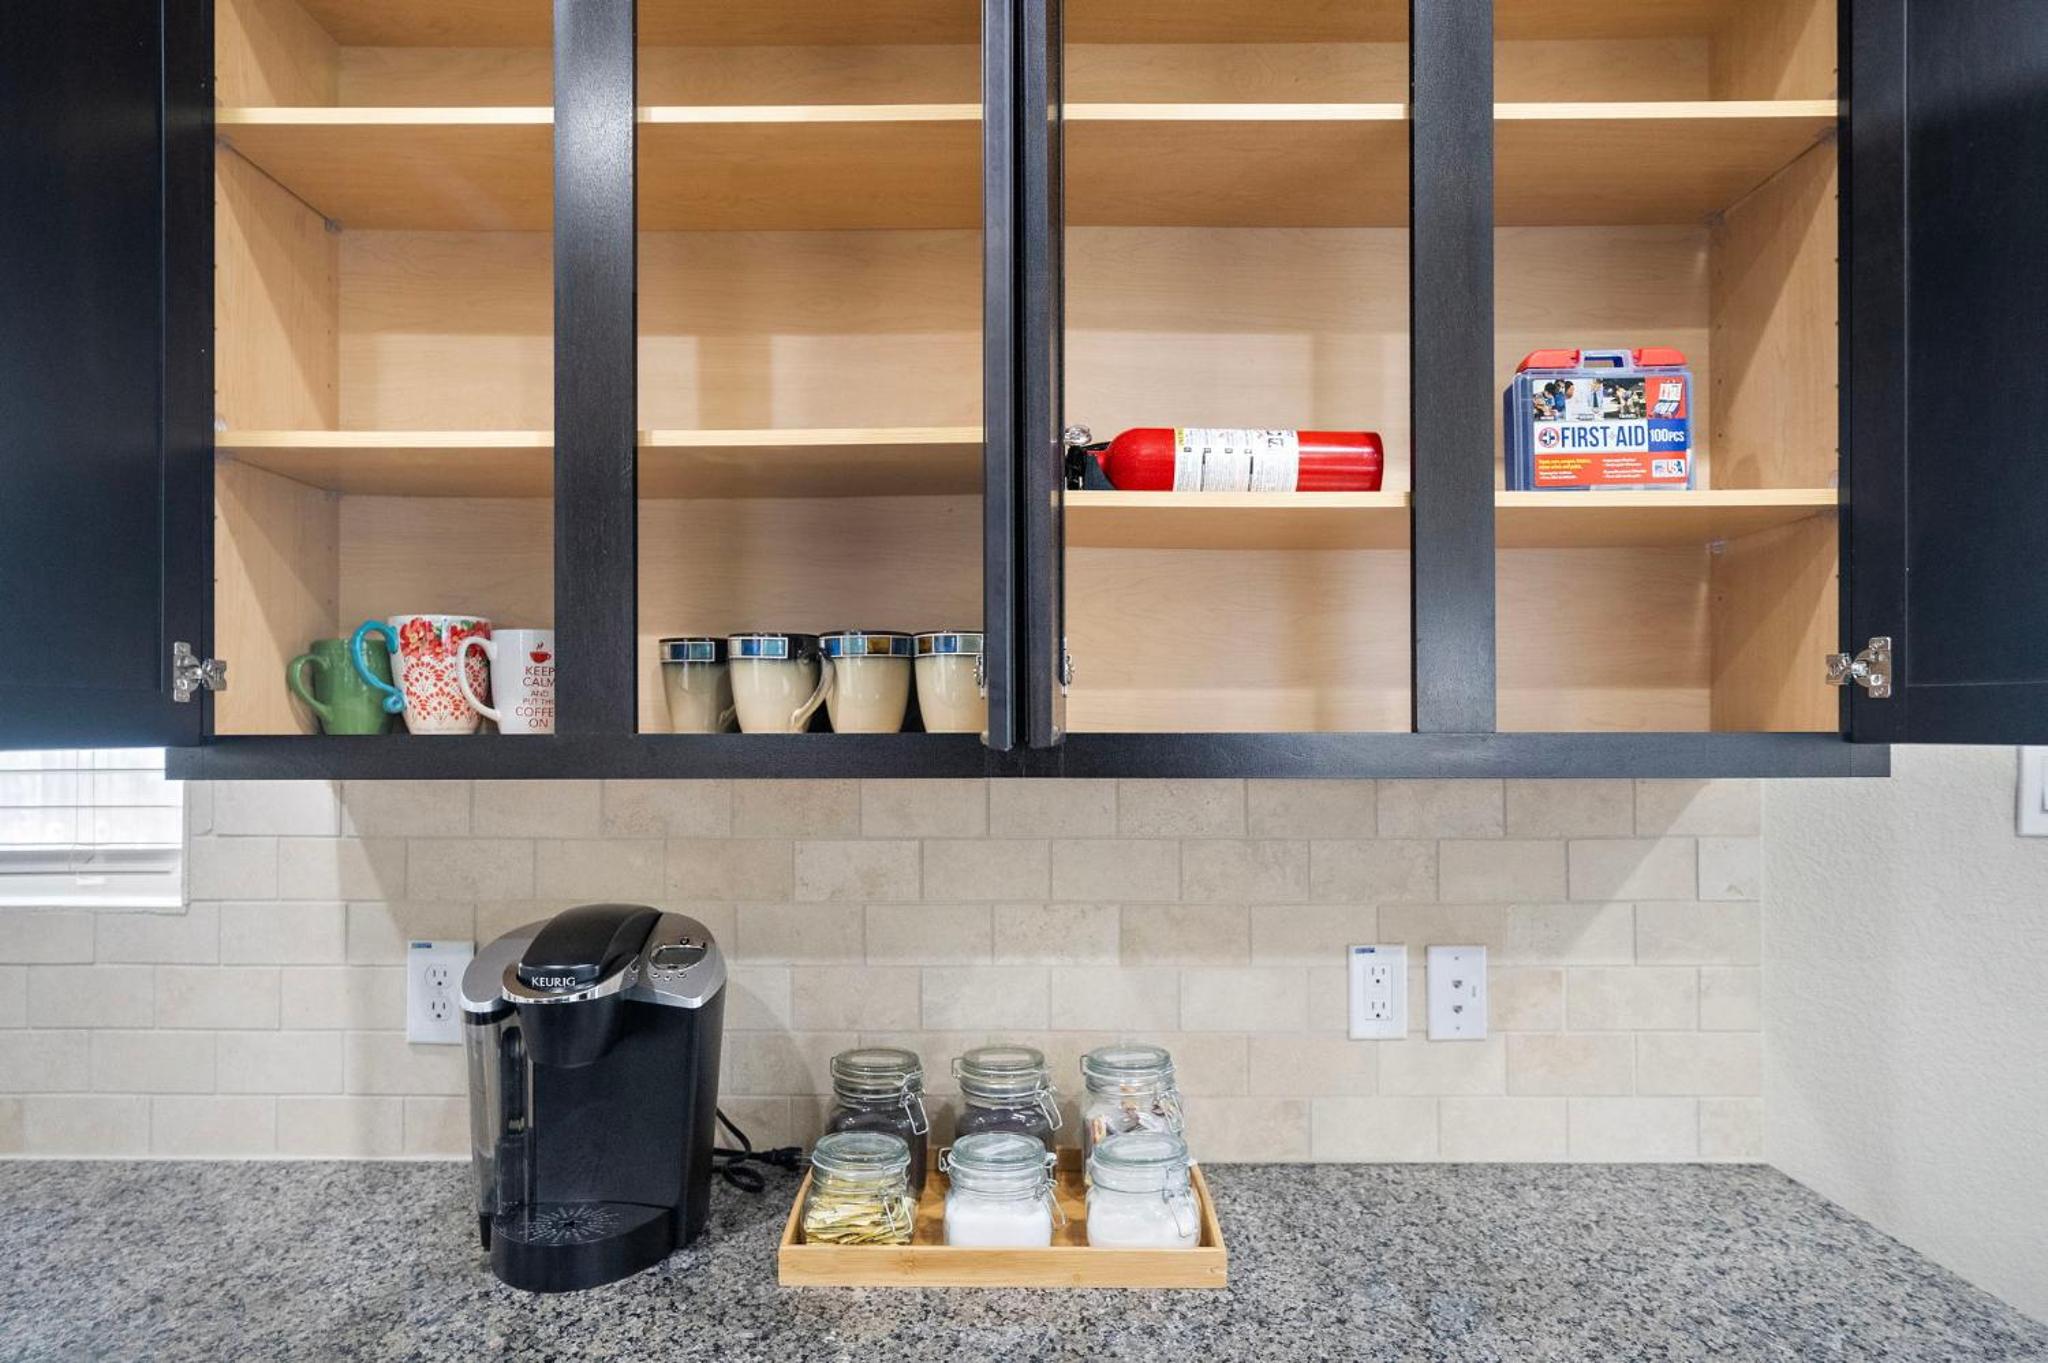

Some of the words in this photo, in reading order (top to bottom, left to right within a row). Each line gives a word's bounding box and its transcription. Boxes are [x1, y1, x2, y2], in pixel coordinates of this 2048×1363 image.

[1561, 426, 1610, 448] FIRST
[1616, 425, 1646, 447] AID
[525, 665, 555, 676] KEEP
[522, 677, 555, 687] CALM
[515, 706, 554, 717] COFFE
[528, 718, 549, 728] ON
[531, 976, 576, 987] KEURIG
